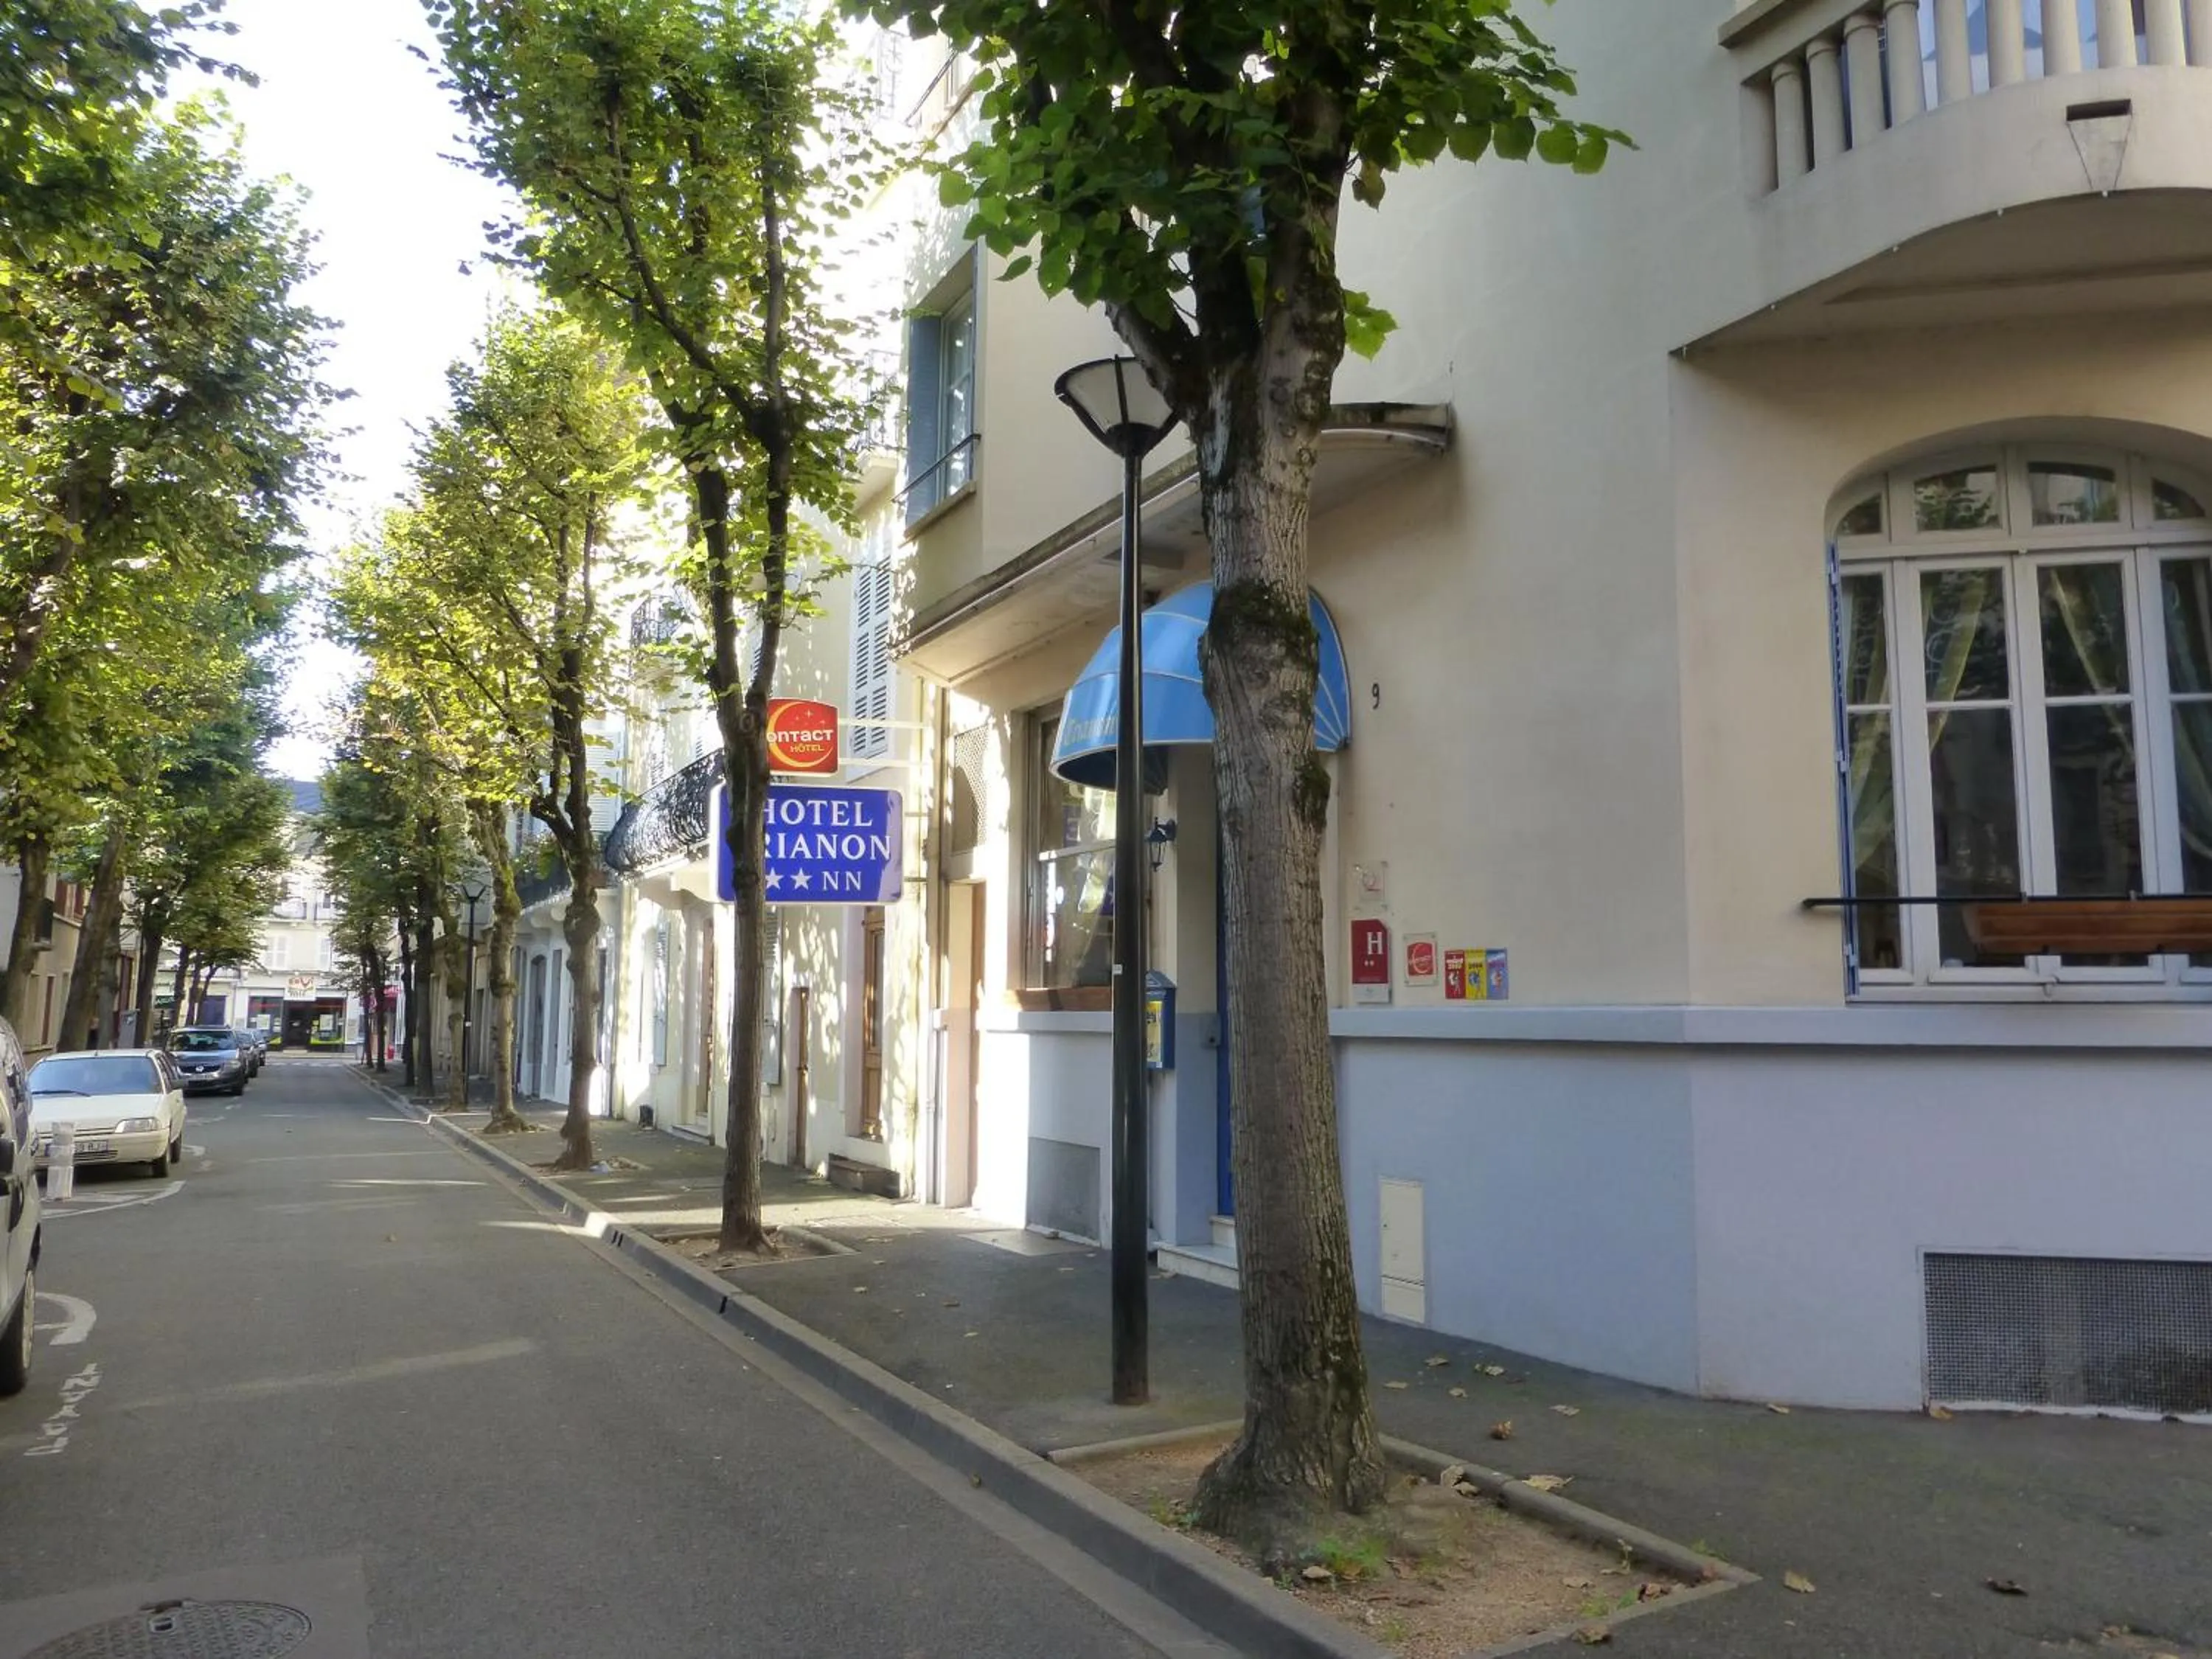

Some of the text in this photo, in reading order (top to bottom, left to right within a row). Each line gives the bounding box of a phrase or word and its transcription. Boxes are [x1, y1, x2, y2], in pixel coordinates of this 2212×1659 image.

[1372, 683, 1380, 709] 9
[821, 871, 861, 891] NN
[1367, 931, 1383, 955] H
